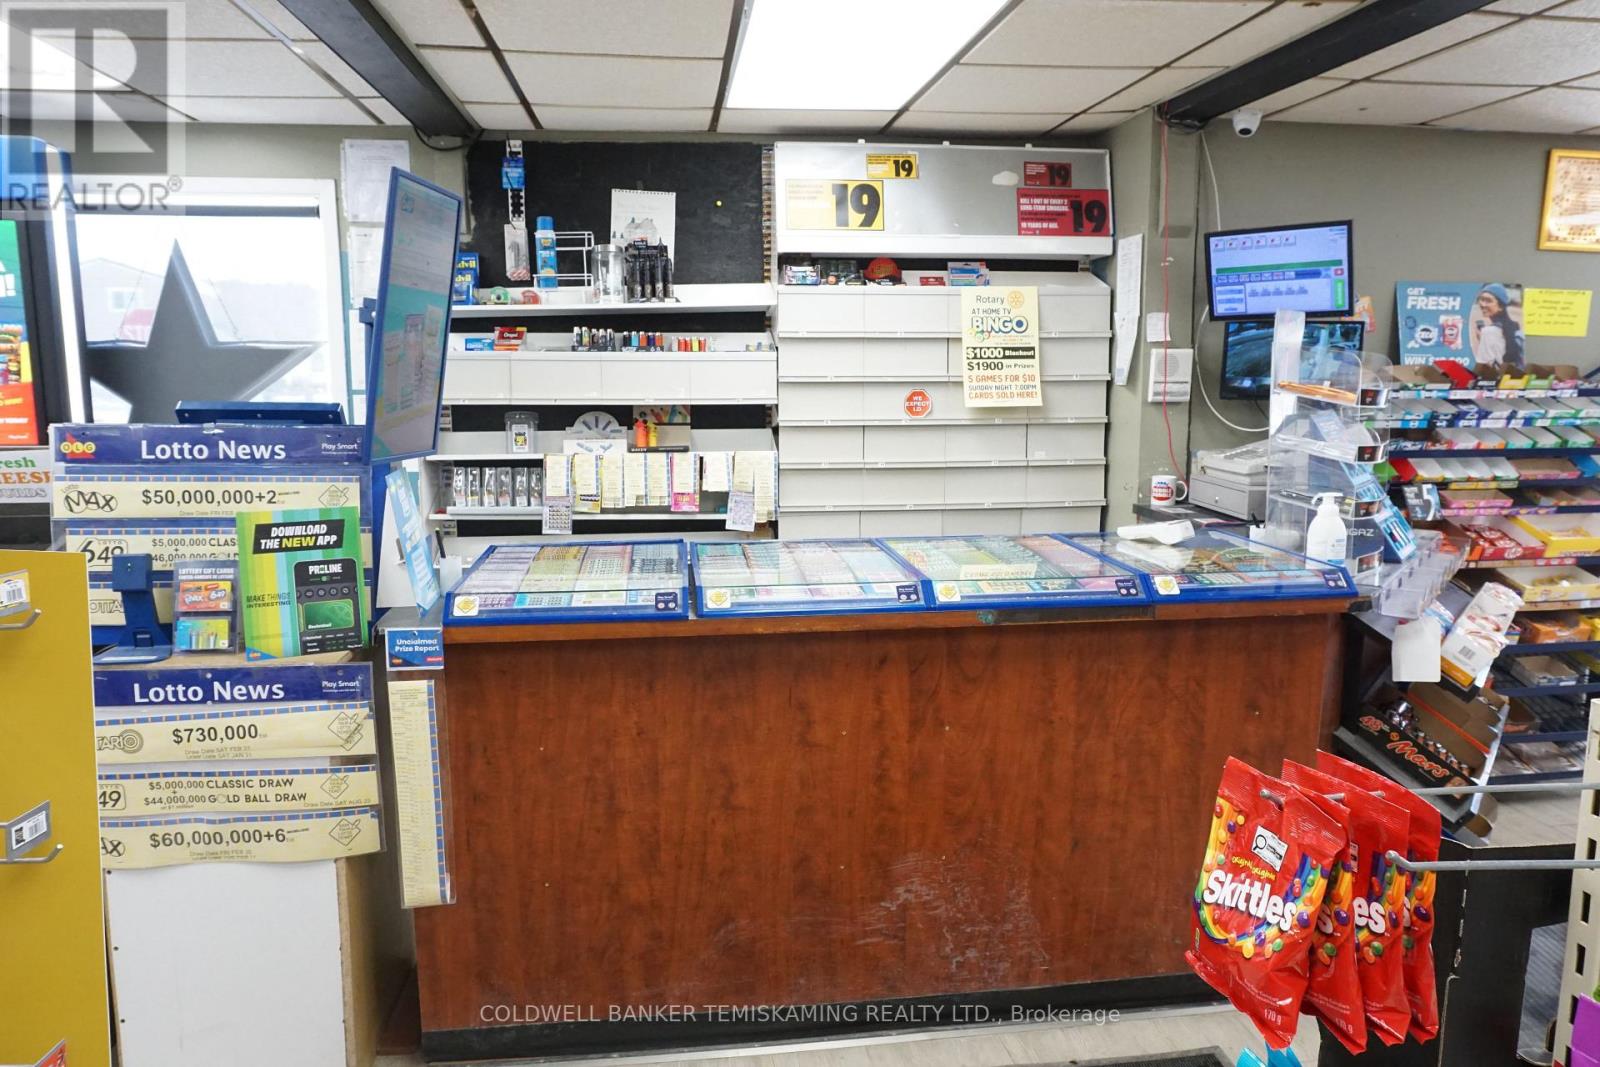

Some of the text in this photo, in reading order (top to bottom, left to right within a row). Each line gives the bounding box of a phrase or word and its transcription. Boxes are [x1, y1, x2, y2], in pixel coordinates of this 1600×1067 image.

[893, 160, 913, 177] 19
[1048, 164, 1069, 186] 19
[832, 183, 881, 228] 19
[1071, 200, 1106, 233] 19
[976, 295, 1005, 306] Rotary
[1407, 297, 1461, 310] FRESH
[971, 316, 1029, 334] BINGO
[966, 347, 1004, 359] $1000
[967, 361, 1004, 371] $1900
[975, 375, 1003, 383] GAMES
[1022, 374, 1036, 382] $10
[968, 390, 1038, 399] CARDS SOLD HERE!
[141, 440, 286, 460] Lotto News
[142, 489, 277, 506] $50,000,000+2
[271, 524, 328, 537] DOWNLOAD
[152, 538, 207, 548] $5,000,000
[260, 535, 338, 549] THE NEW APP
[246, 594, 266, 603] MAKE
[246, 601, 291, 609] INTERESTING
[395, 645, 439, 654] Prize Report
[133, 680, 285, 703] Lotto News
[172, 724, 259, 745] $730,000
[1387, 739, 1449, 779] Mars
[149, 778, 294, 792] $5,000,000 CLASSIC DRAW
[99, 790, 122, 808] 49
[144, 794, 207, 807] $44,000,000
[244, 793, 271, 803] BALL
[274, 792, 307, 803] DRAW
[150, 828, 286, 849] $60,000,000+6
[1202, 869, 1297, 932] Skittles
[1352, 896, 1386, 934] es
[1264, 1009, 1277, 1022] 170
